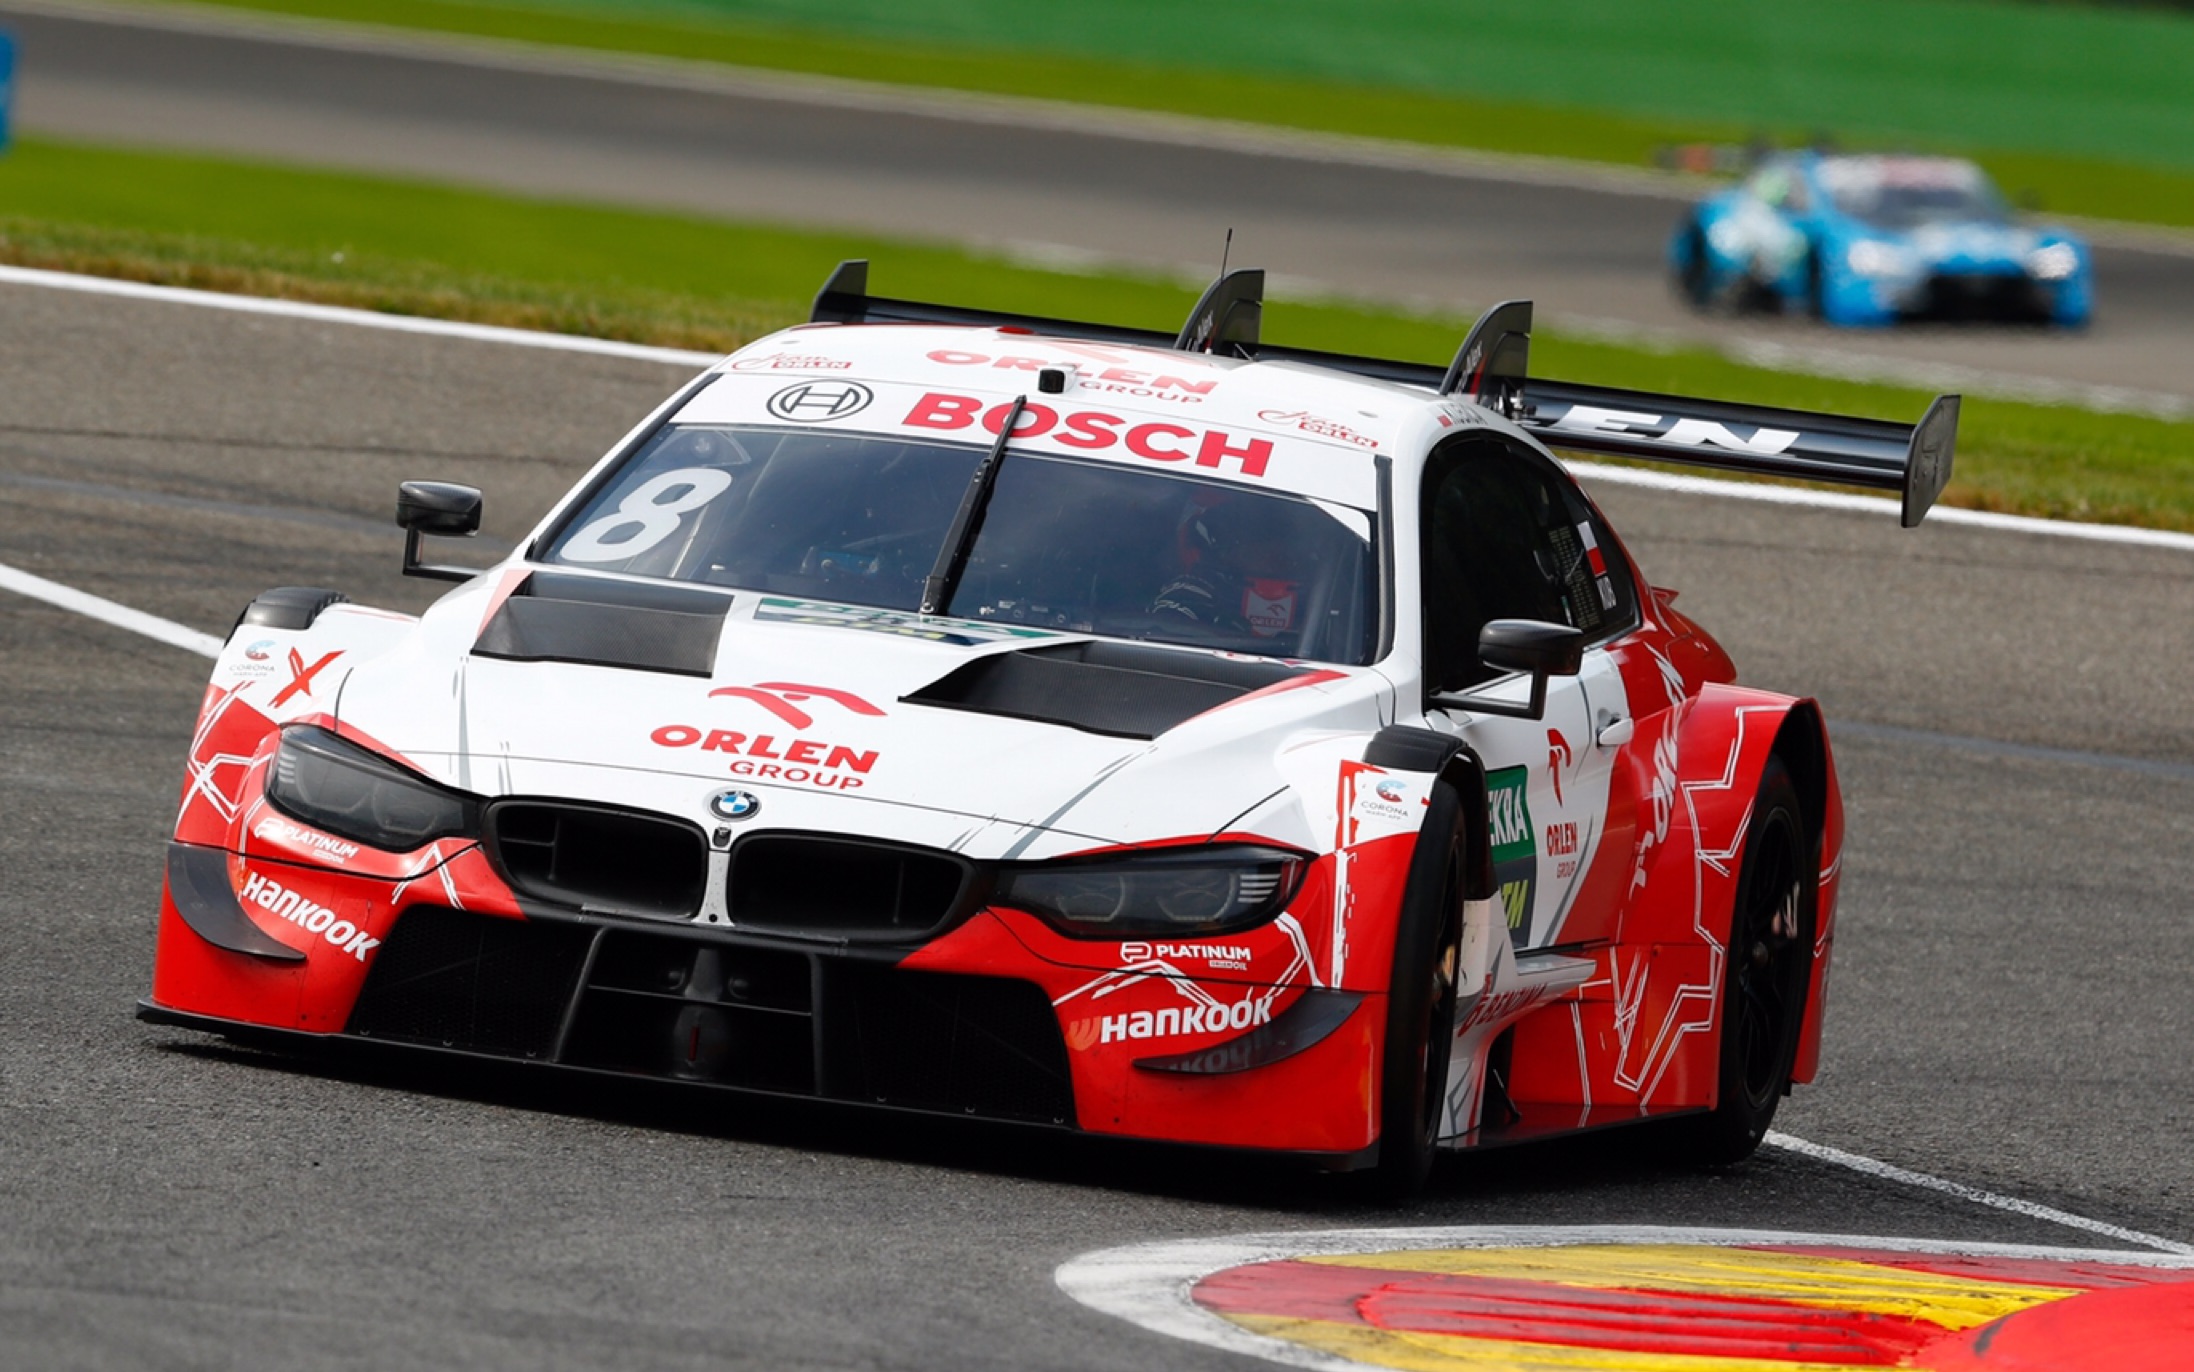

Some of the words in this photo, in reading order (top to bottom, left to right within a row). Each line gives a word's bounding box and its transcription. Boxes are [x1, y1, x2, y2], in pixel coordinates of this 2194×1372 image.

[1079, 380, 1203, 403] GROUP
[901, 391, 1274, 477] BOSCH
[560, 468, 733, 562] 8
[228, 663, 275, 672] CORONA
[650, 724, 880, 774] ORLEN
[729, 760, 864, 790] GROUP
[1360, 800, 1409, 817] CORONA
[1487, 784, 1529, 846] EKRA
[284, 825, 360, 859] PLATINUM
[1547, 821, 1578, 857] ORLEN
[1502, 879, 1529, 929] TM
[1156, 944, 1252, 962] PLATINUM
